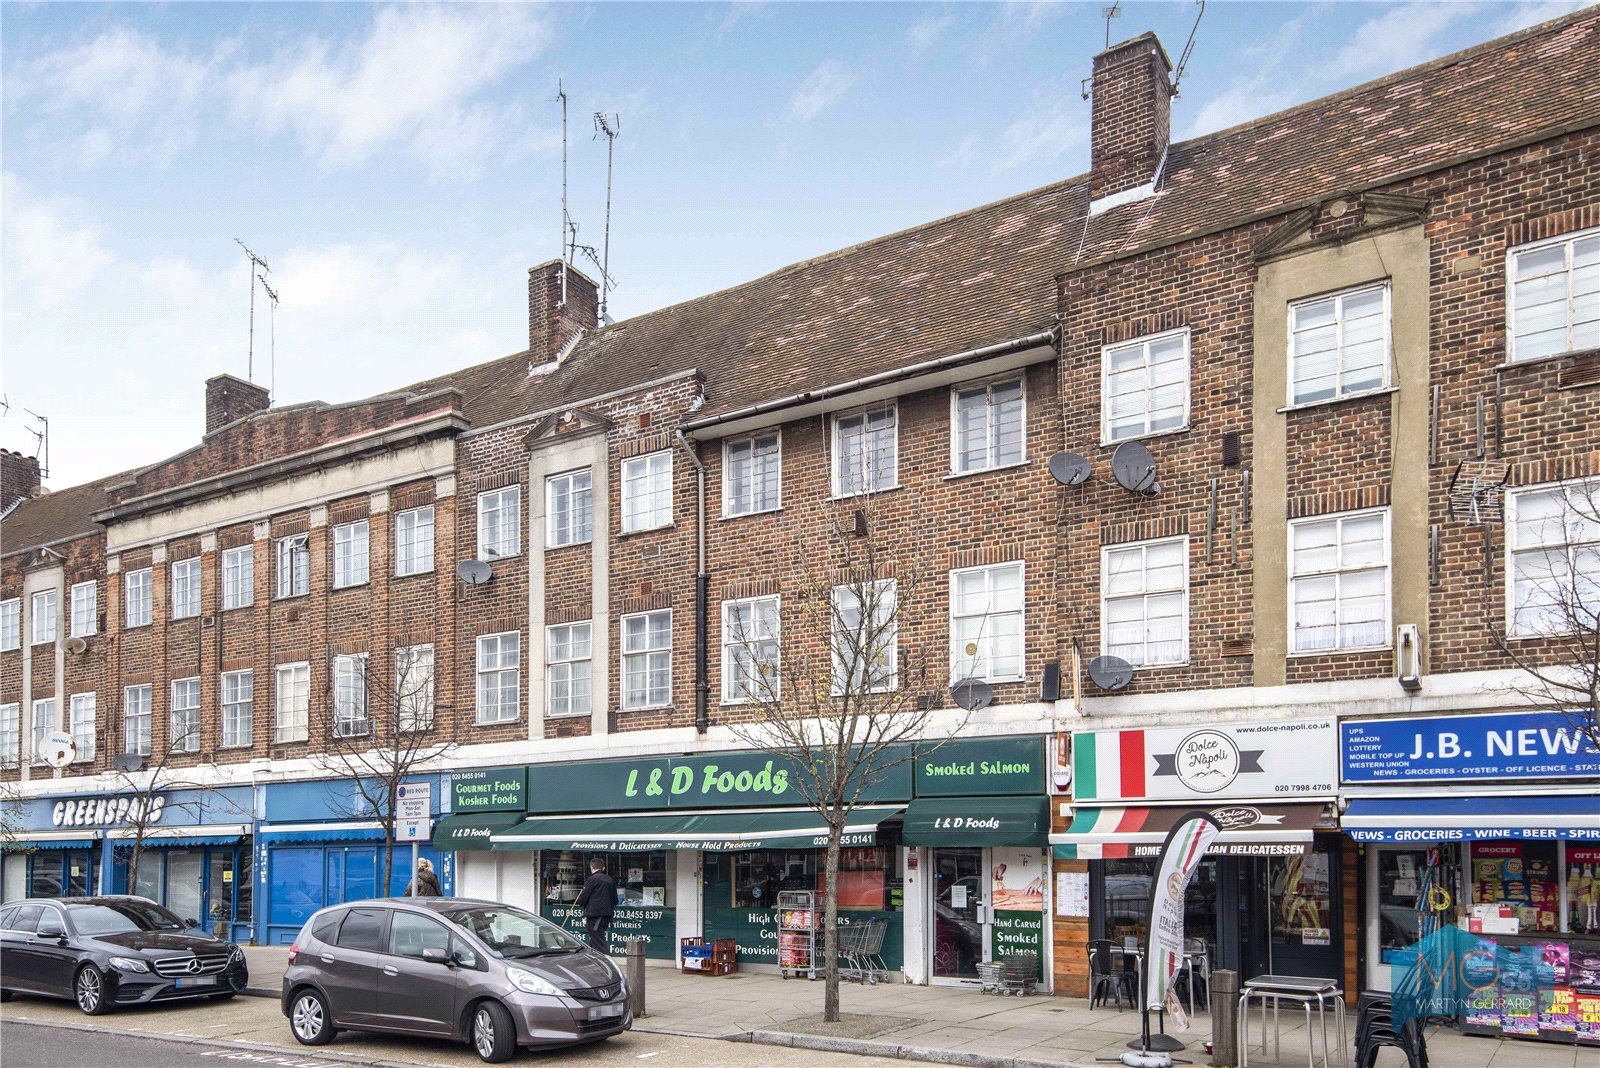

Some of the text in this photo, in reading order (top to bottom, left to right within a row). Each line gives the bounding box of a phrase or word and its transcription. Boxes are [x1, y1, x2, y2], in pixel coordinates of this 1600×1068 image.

[1236, 722, 1331, 734] www.dolce-napoli.co.uk
[1185, 738, 1219, 754] Dolce
[1349, 744, 1382, 752] LOTTERY
[1409, 732, 1472, 760] J.B.
[1349, 761, 1385, 769] WESTERN
[1404, 767, 1455, 775] GROCERIES
[1462, 766, 1499, 774] OYSTER
[1526, 764, 1567, 772] LICENCE
[462, 772, 474, 780] 8455
[474, 771, 486, 779] 0141
[645, 767, 664, 796] &
[670, 765, 694, 795] D
[701, 760, 789, 795] Foods
[495, 780, 521, 792] Foods
[1274, 783, 1332, 792] 020 7998 4706
[491, 793, 518, 805] Foods
[943, 818, 951, 828] &
[953, 817, 963, 828] D
[965, 816, 1000, 829] Foods
[463, 828, 471, 837] D
[470, 827, 492, 837] Foods
[1394, 830, 1463, 840] GROCERIES
[1474, 829, 1511, 838] WINE
[1522, 829, 1557, 838] BEER
[813, 837, 828, 845] 020
[852, 834, 873, 844] 0141
[1135, 846, 1162, 855] HOME
[1229, 844, 1305, 854] DELICATESSEN
[552, 909, 565, 917] 020
[626, 910, 644, 919] 8455
[645, 911, 663, 920] 8397
[748, 913, 770, 925] High
